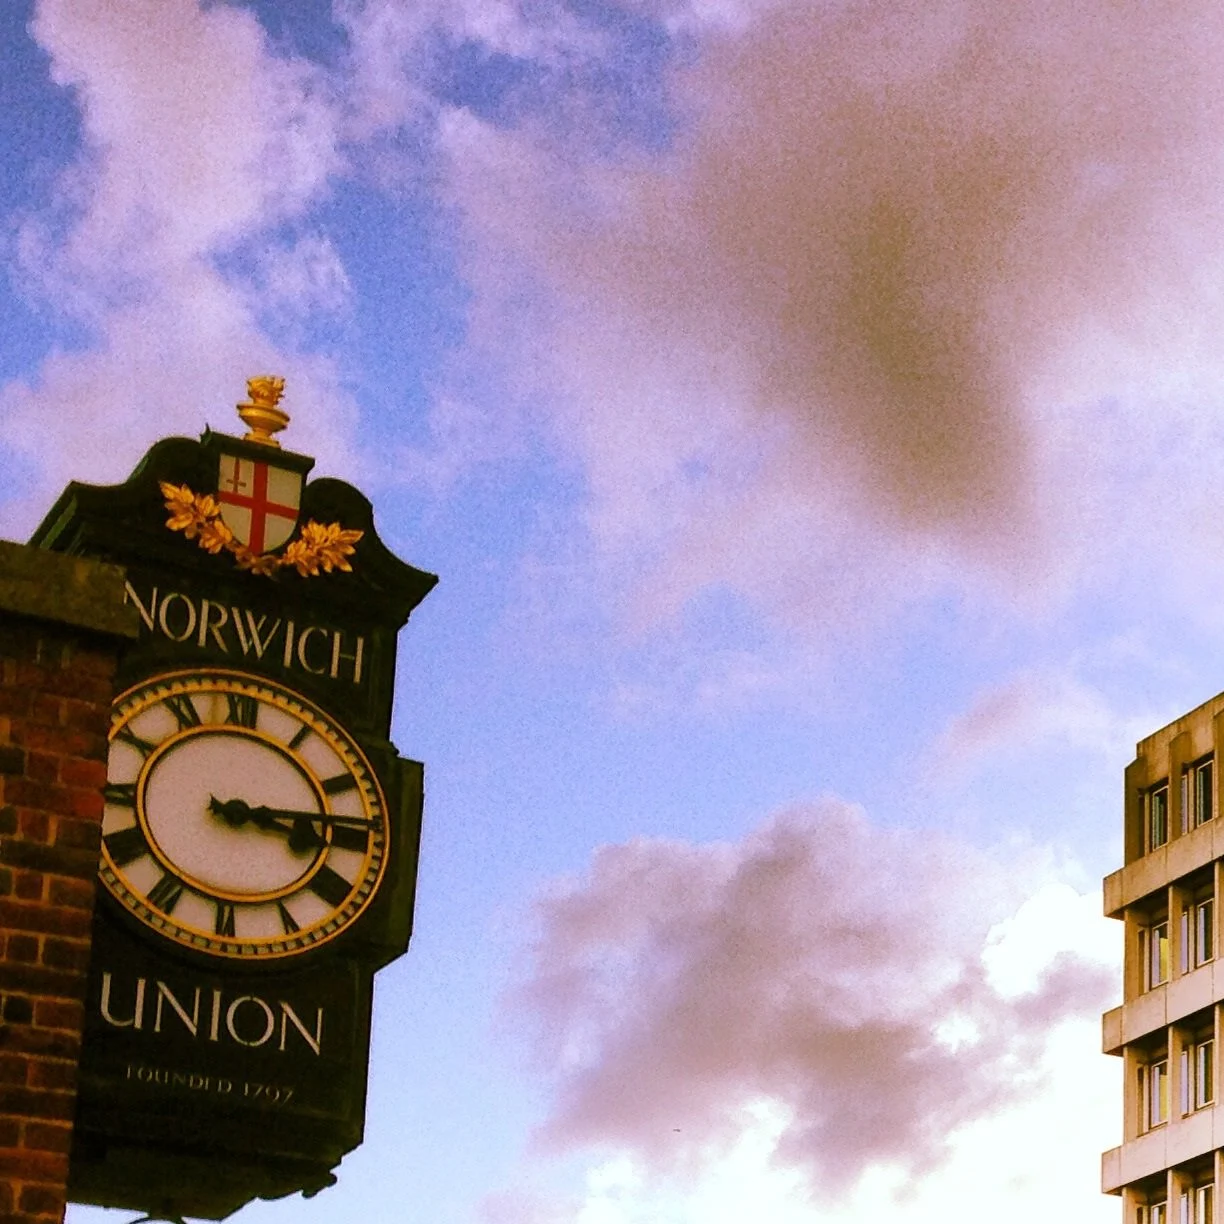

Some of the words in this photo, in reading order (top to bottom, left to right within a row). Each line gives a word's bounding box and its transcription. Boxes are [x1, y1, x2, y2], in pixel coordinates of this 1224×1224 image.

[123, 578, 365, 685] NORWICH
[101, 971, 324, 1056] UNION
[126, 1064, 232, 1095] FOUNDED
[243, 1081, 295, 1106] 1797
